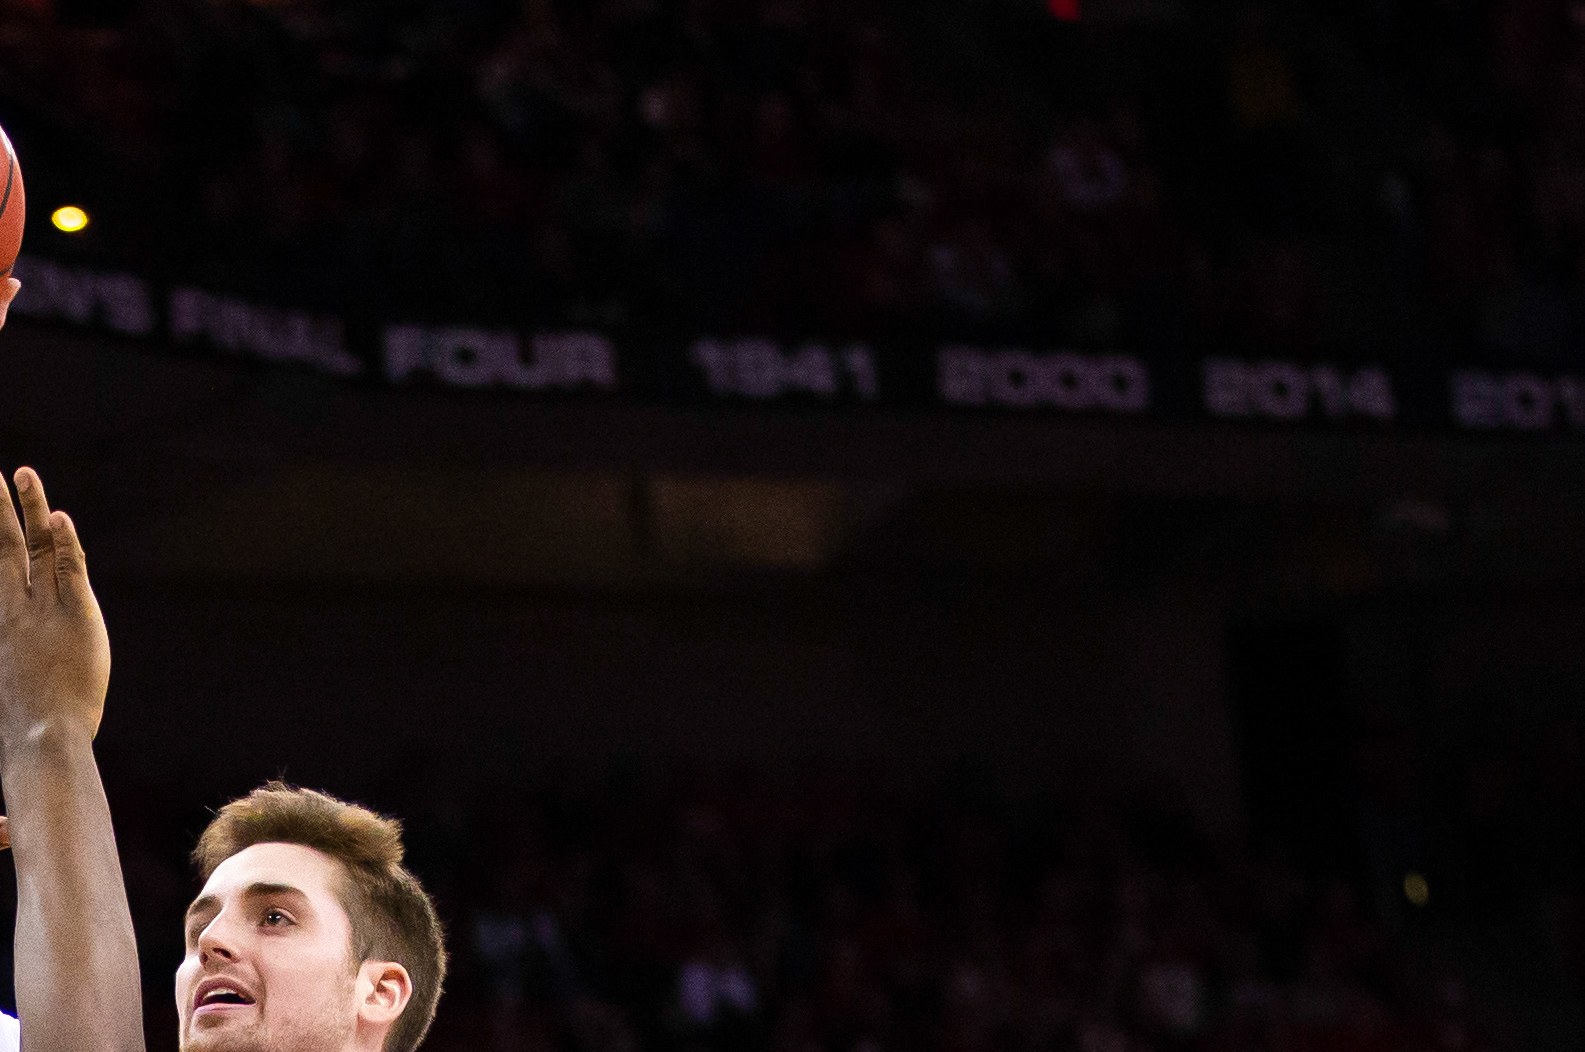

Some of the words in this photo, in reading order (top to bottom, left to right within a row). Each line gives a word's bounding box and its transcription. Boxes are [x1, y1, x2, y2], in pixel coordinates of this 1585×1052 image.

[381, 323, 616, 390] FOUR
[688, 335, 880, 400] 1941
[934, 345, 1150, 414] 2000
[1200, 355, 1396, 421] 2014
